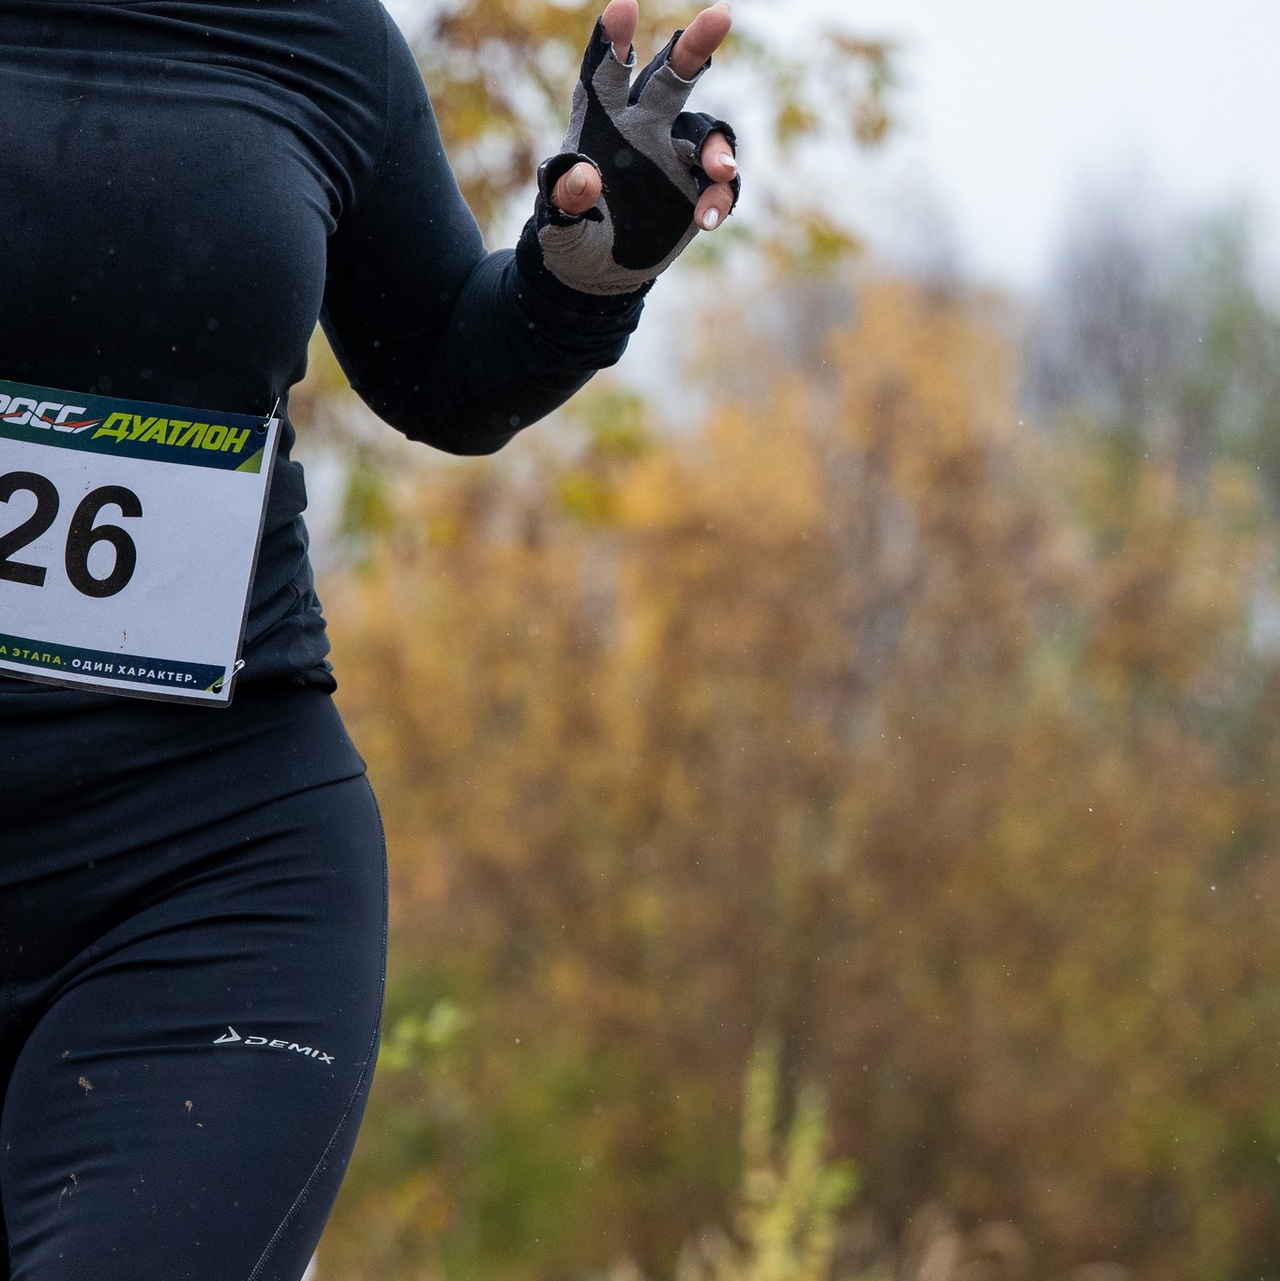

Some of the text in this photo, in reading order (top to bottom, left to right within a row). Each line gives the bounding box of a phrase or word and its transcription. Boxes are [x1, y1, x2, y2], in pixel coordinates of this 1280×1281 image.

[91, 412, 251, 453] ДУАТЛОН
[12, 648, 67, 666] ЭТАПА.
[71, 659, 114, 673] ОДИН
[117, 665, 198, 683] ХАРАКТЕР.
[244, 1036, 335, 1065] DEMIX
